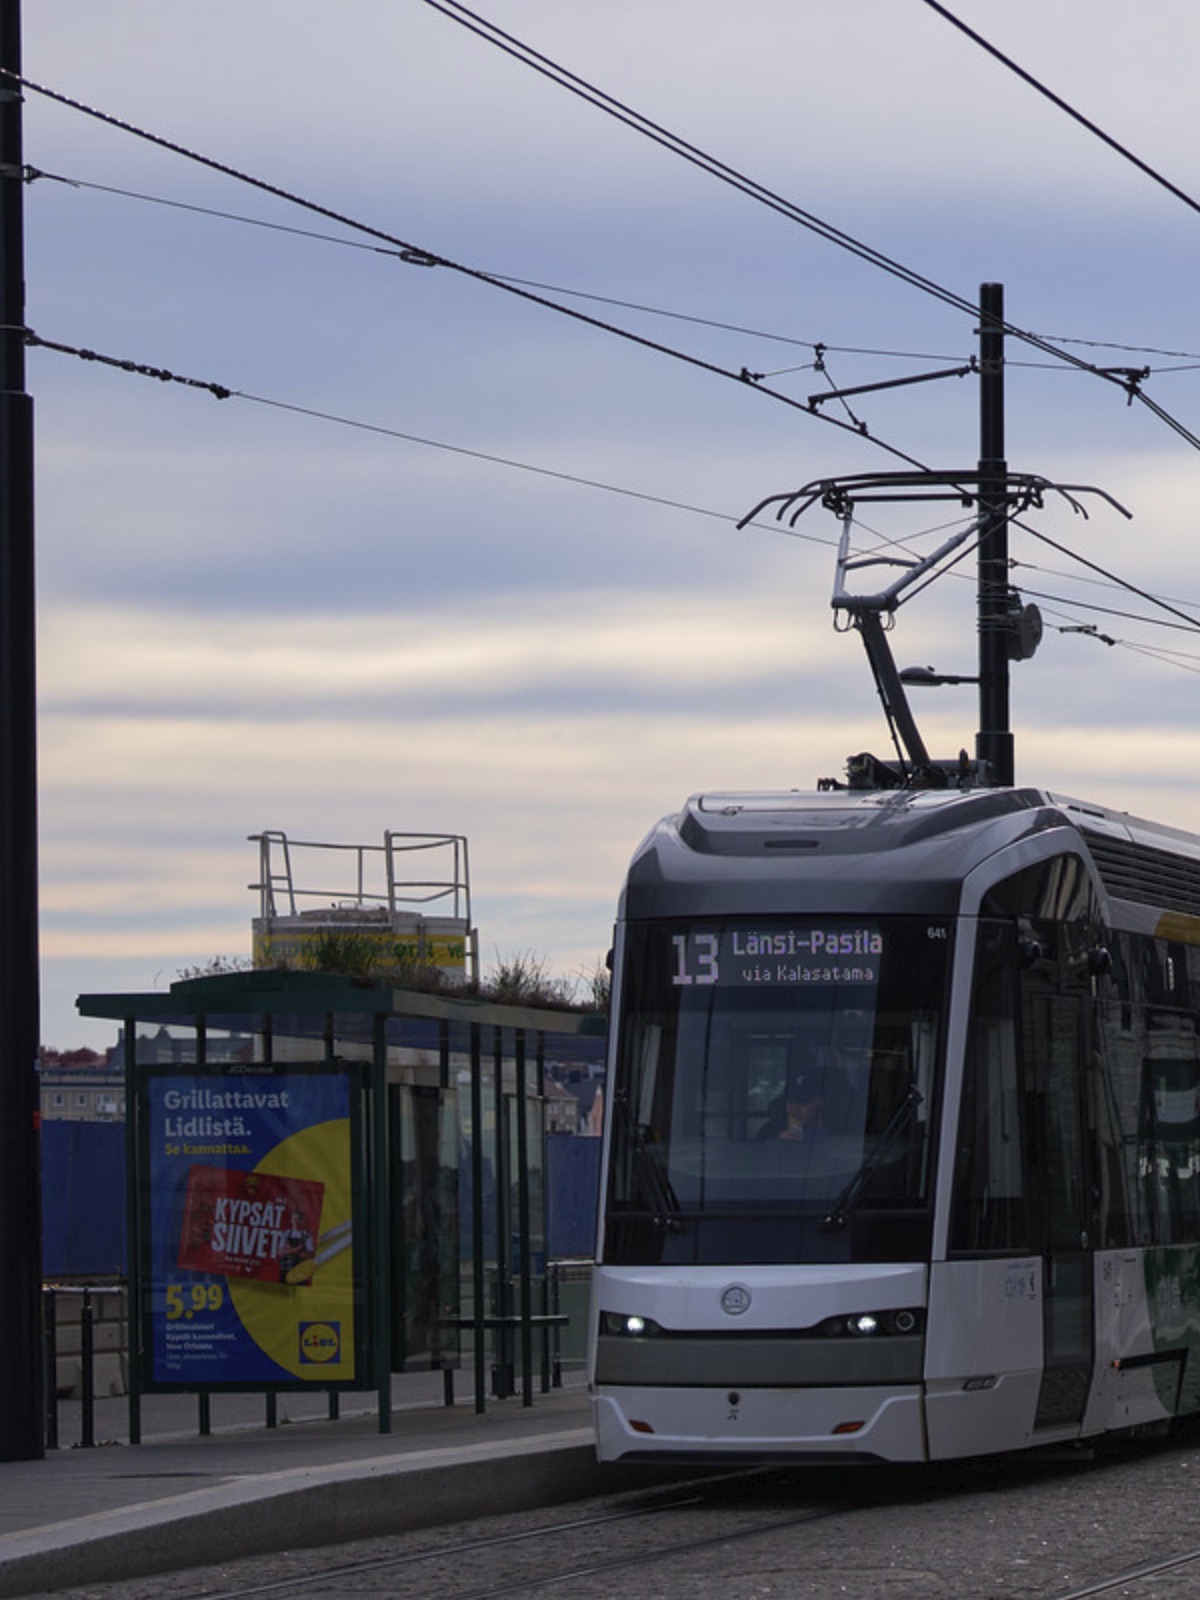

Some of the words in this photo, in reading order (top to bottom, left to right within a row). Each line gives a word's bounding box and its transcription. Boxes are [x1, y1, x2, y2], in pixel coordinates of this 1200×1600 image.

[927, 927, 947, 939] 641
[672, 934, 719, 985] 13
[732, 930, 883, 955] Länsi-Pasila
[742, 965, 771, 981] via
[777, 965, 873, 981] Kalasatama
[163, 1089, 289, 1109] Grillattavat
[164, 1116, 252, 1137] Lidlistä.
[164, 1143, 180, 1155] Se
[183, 1143, 252, 1155] kannattaa.
[211, 1222, 283, 1260] SIIVET
[166, 1284, 224, 1321] 5.99
